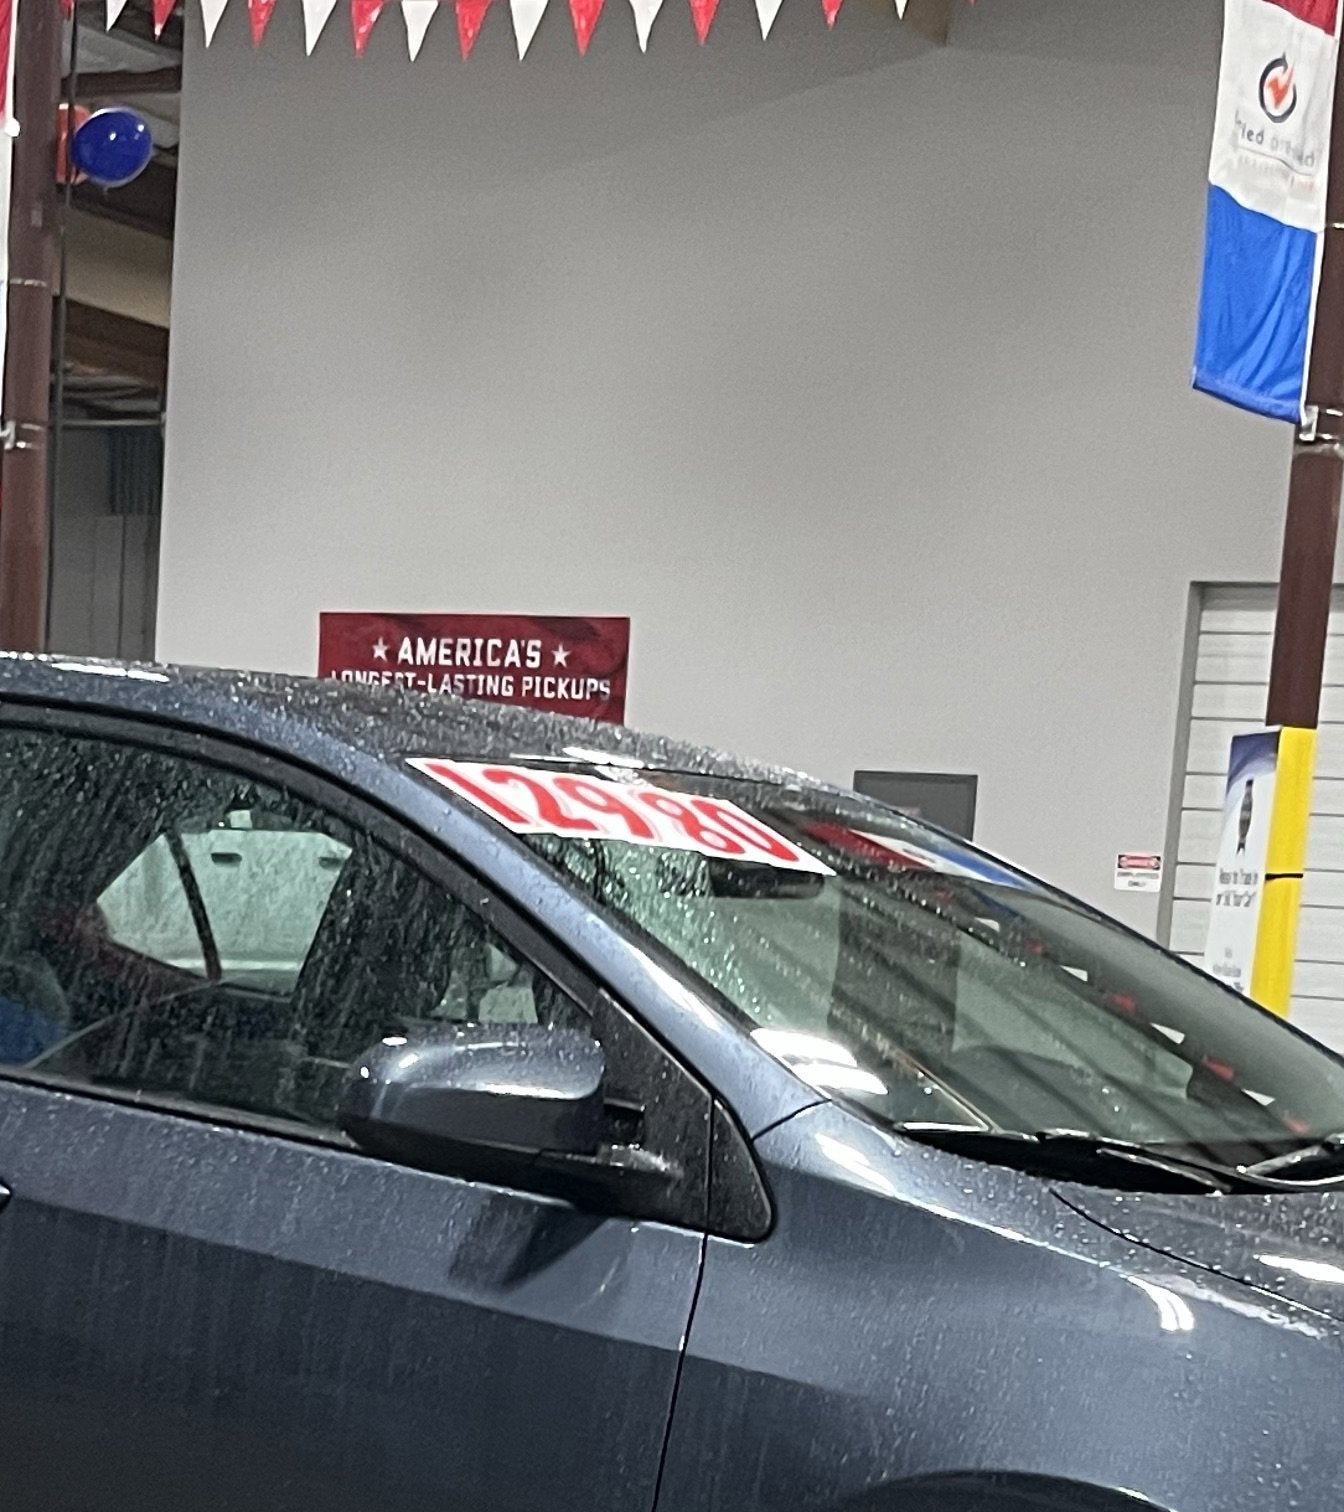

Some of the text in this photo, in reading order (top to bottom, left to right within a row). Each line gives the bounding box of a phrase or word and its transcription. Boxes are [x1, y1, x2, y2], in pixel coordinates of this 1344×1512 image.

[397, 636, 542, 668] AMERICA'S
[522, 675, 611, 701] PICKUPS
[423, 763, 800, 862] 12980
